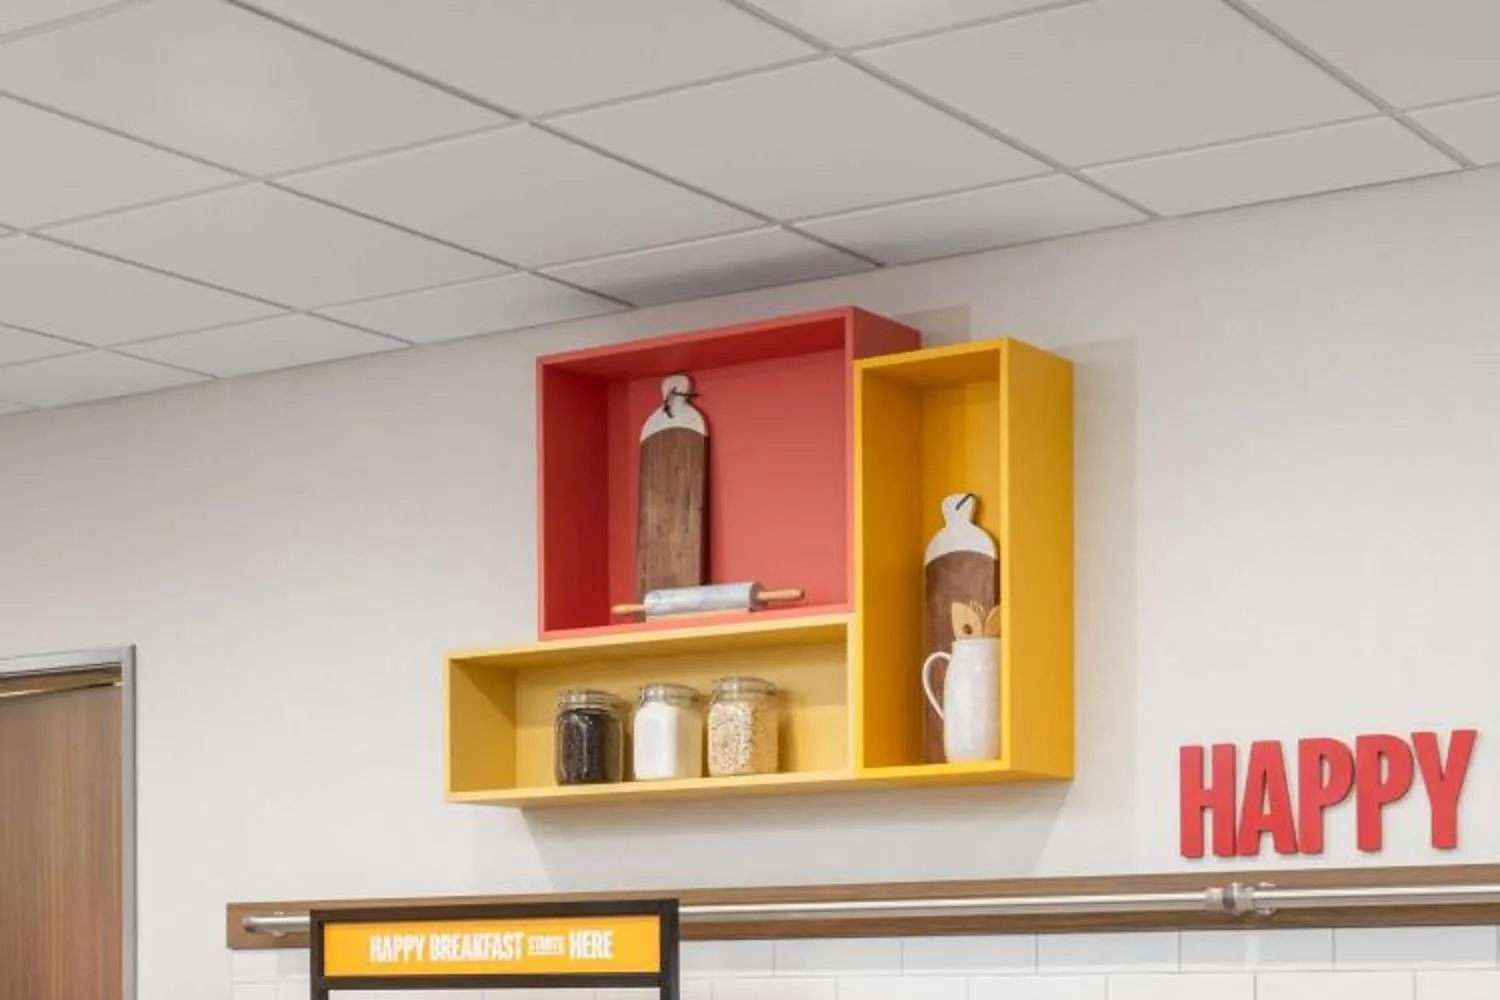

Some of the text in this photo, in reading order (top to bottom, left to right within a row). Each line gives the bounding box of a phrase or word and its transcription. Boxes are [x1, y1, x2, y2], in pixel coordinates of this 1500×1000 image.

[1179, 728, 1477, 859] HAPPY
[369, 934, 425, 962] HAPPY
[429, 931, 525, 961] BREAKFAST
[570, 930, 614, 960] HERE
